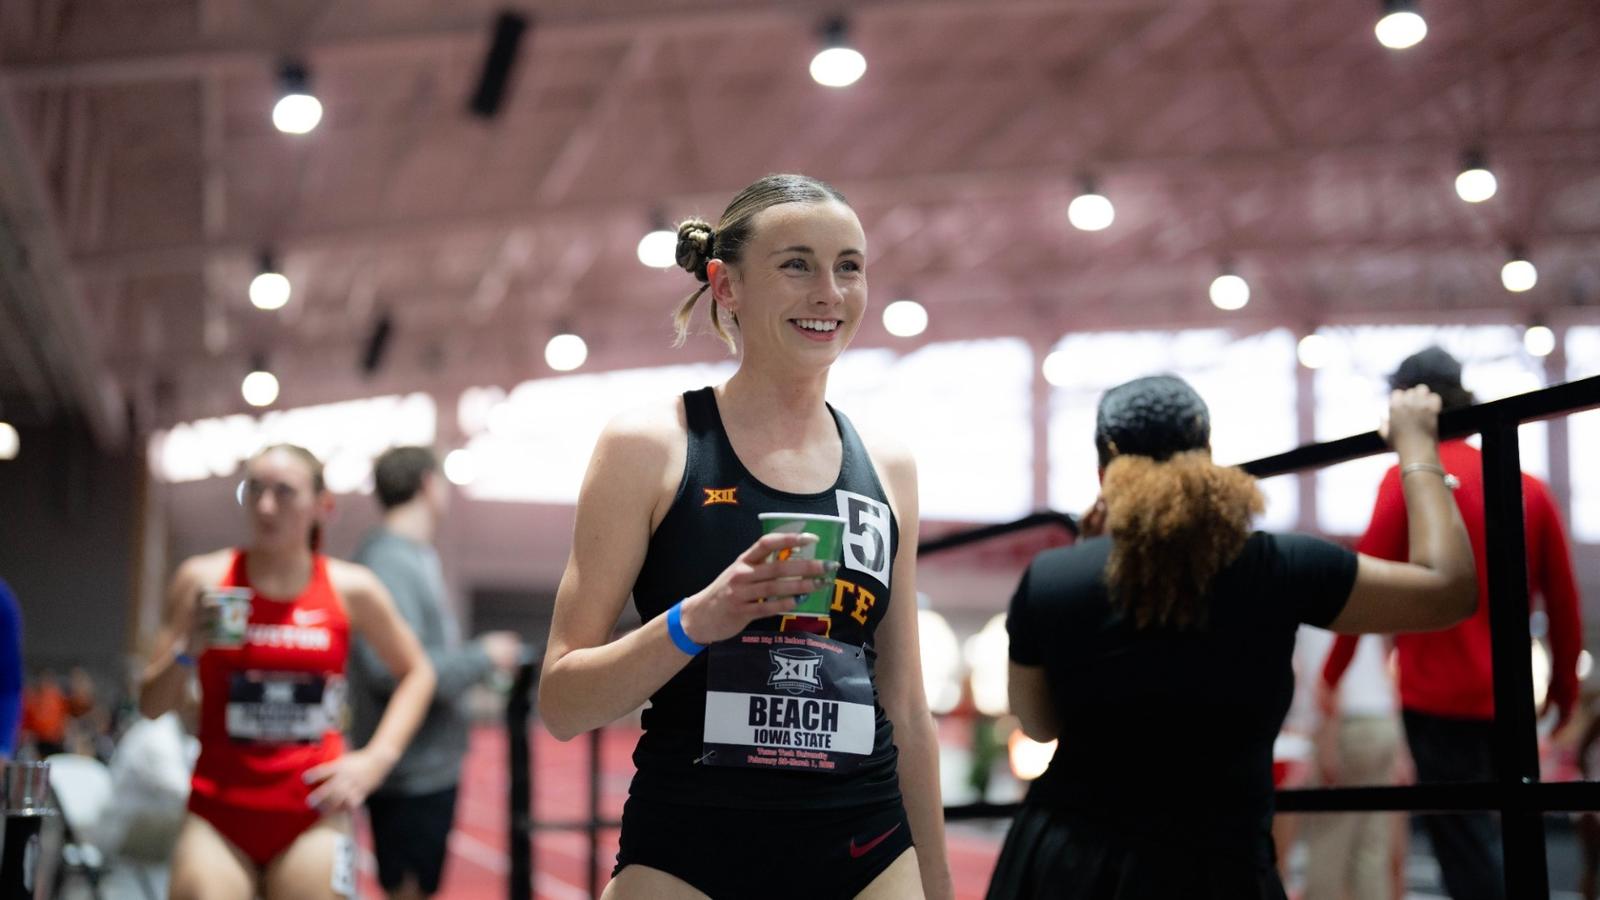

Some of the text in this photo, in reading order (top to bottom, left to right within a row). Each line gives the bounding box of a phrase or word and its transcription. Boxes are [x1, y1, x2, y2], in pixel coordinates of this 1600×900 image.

[704, 487, 739, 506] XII
[847, 496, 885, 573] 5
[771, 655, 821, 683] XII
[748, 696, 839, 732] BEACH
[754, 729, 832, 749] IOWA STATE
